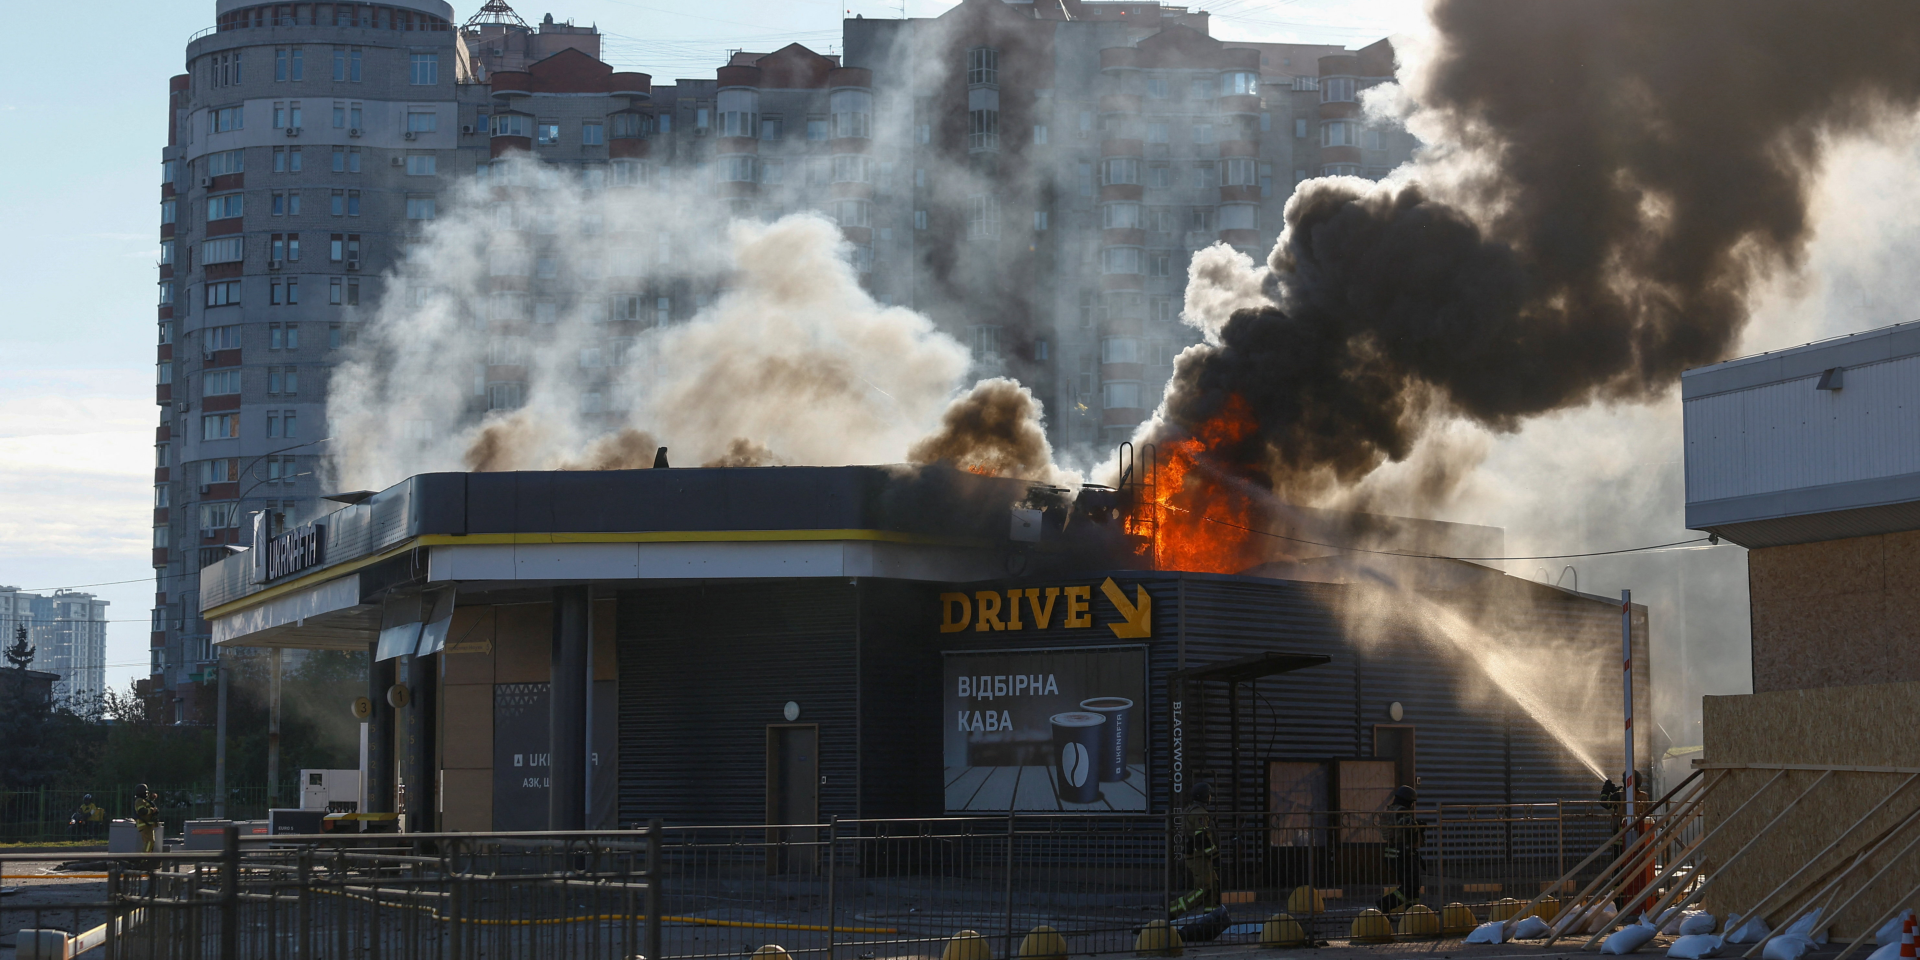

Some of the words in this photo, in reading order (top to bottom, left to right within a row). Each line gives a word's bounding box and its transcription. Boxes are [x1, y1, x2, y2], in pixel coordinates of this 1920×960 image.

[269, 524, 316, 580] UKRNAFTA
[940, 585, 1091, 633] DRIVE
[397, 690, 403, 702] 1
[958, 674, 1059, 700] ВІДБІРНА
[361, 702, 367, 713] 3
[958, 710, 1013, 731] КАВА
[1173, 701, 1183, 793] BLACKWOOD
